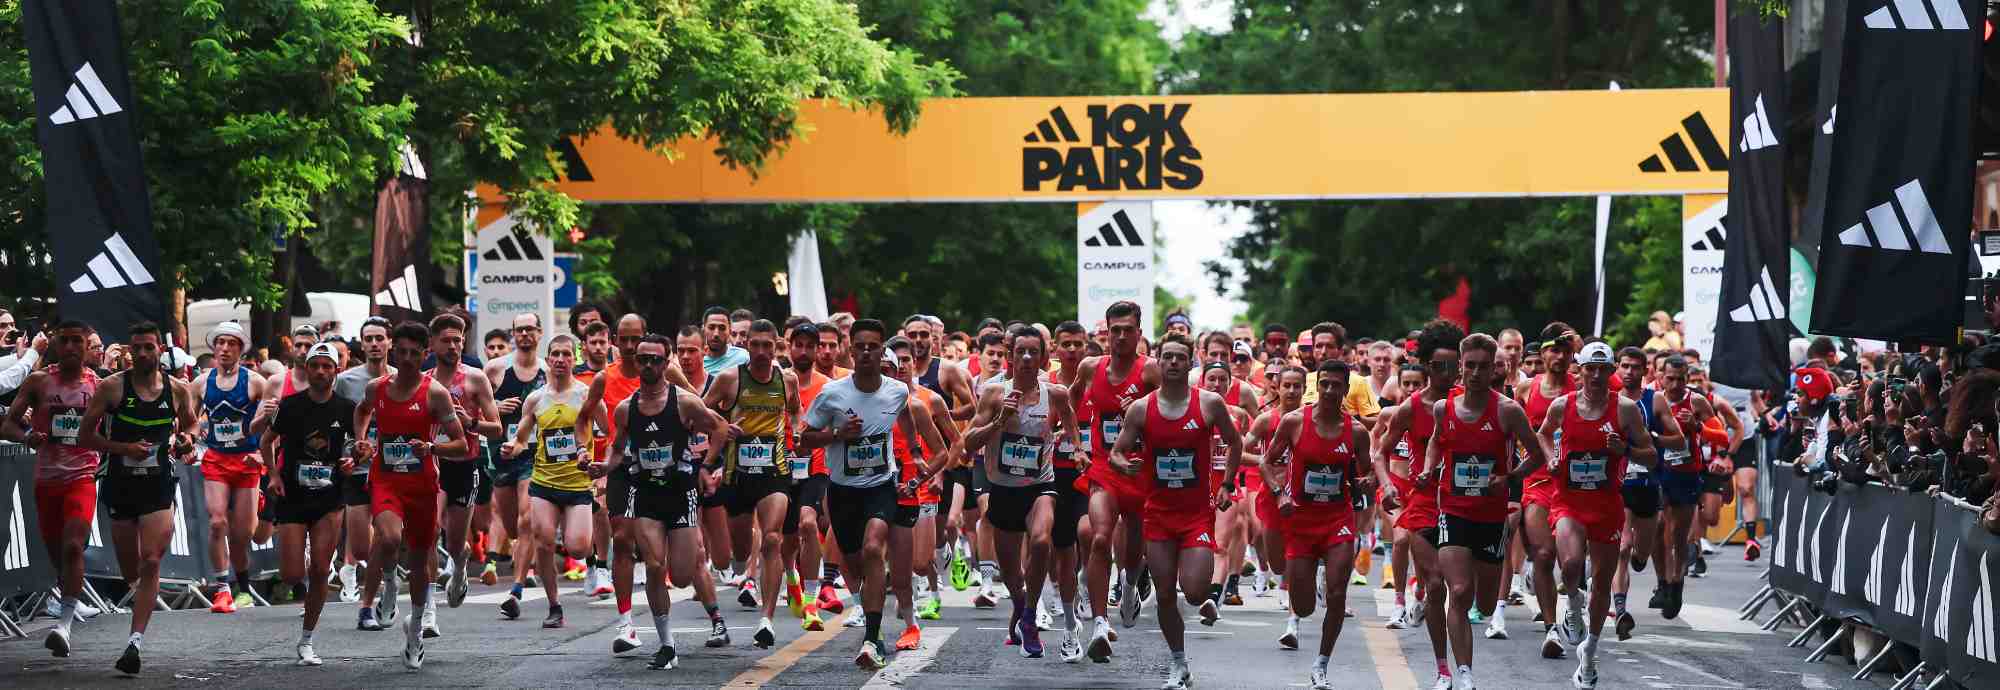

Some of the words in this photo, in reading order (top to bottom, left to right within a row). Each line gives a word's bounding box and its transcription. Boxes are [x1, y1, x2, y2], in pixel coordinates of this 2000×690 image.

[1087, 104, 1193, 148] 10K
[1022, 147, 1204, 192] PARIS
[1083, 262, 1146, 270] CAMPUS
[1690, 266, 1723, 274] CAM
[482, 275, 545, 284] CAMPUS
[488, 298, 539, 314] compeed
[552, 437, 567, 449] 150
[391, 444, 407, 457] 107
[747, 446, 764, 459] 129
[1012, 445, 1028, 459] 147
[1169, 458, 1177, 472] 2
[1466, 464, 1480, 479] 48
[1583, 461, 1591, 475] 7
